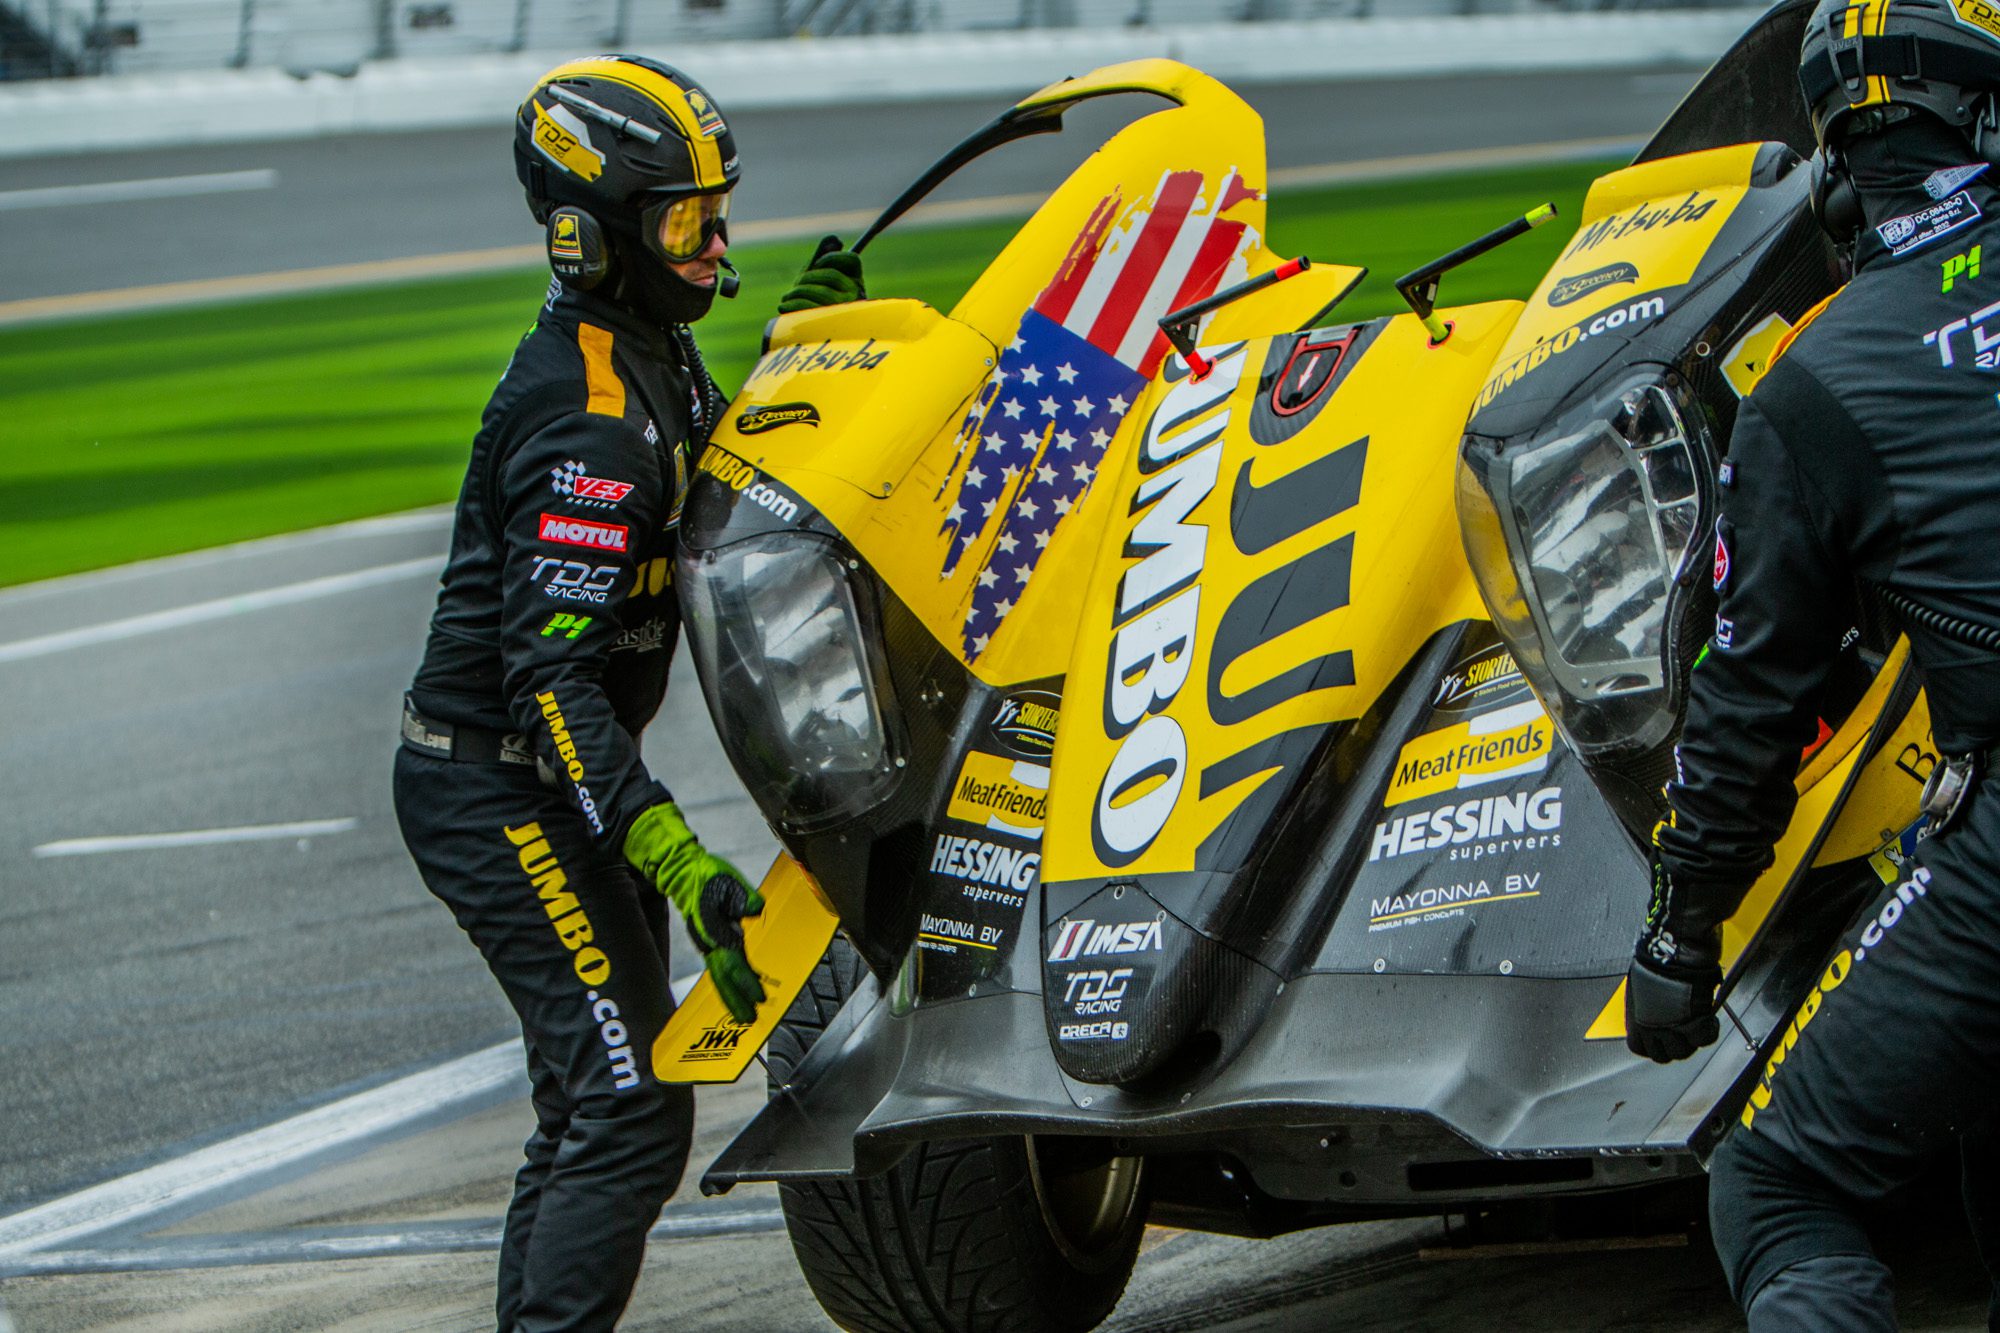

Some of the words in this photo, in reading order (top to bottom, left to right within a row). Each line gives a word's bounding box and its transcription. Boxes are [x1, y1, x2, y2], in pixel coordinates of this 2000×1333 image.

[537, 117, 576, 152] TDS
[542, 520, 625, 548] MOTUL
[530, 555, 621, 591] TDS
[544, 584, 608, 603] RACING
[540, 612, 593, 639] P1
[535, 691, 604, 835] JUMBO.com
[1369, 787, 1562, 862] HESSING
[929, 834, 1041, 891] HESSING
[1449, 834, 1561, 861] supervers
[962, 885, 1023, 908] supervers
[1370, 880, 1491, 916] MAYONNA
[1505, 872, 1541, 893] BV
[920, 913, 974, 939] MAYONNA
[979, 926, 1003, 944] BV
[1083, 921, 1162, 956] IMSA
[503, 821, 641, 1090] JUMBO.com
[1064, 968, 1134, 1002] TDS
[1075, 999, 1122, 1015] RACING
[689, 1028, 749, 1050] JWK
[1060, 1021, 1112, 1039] ORECA
